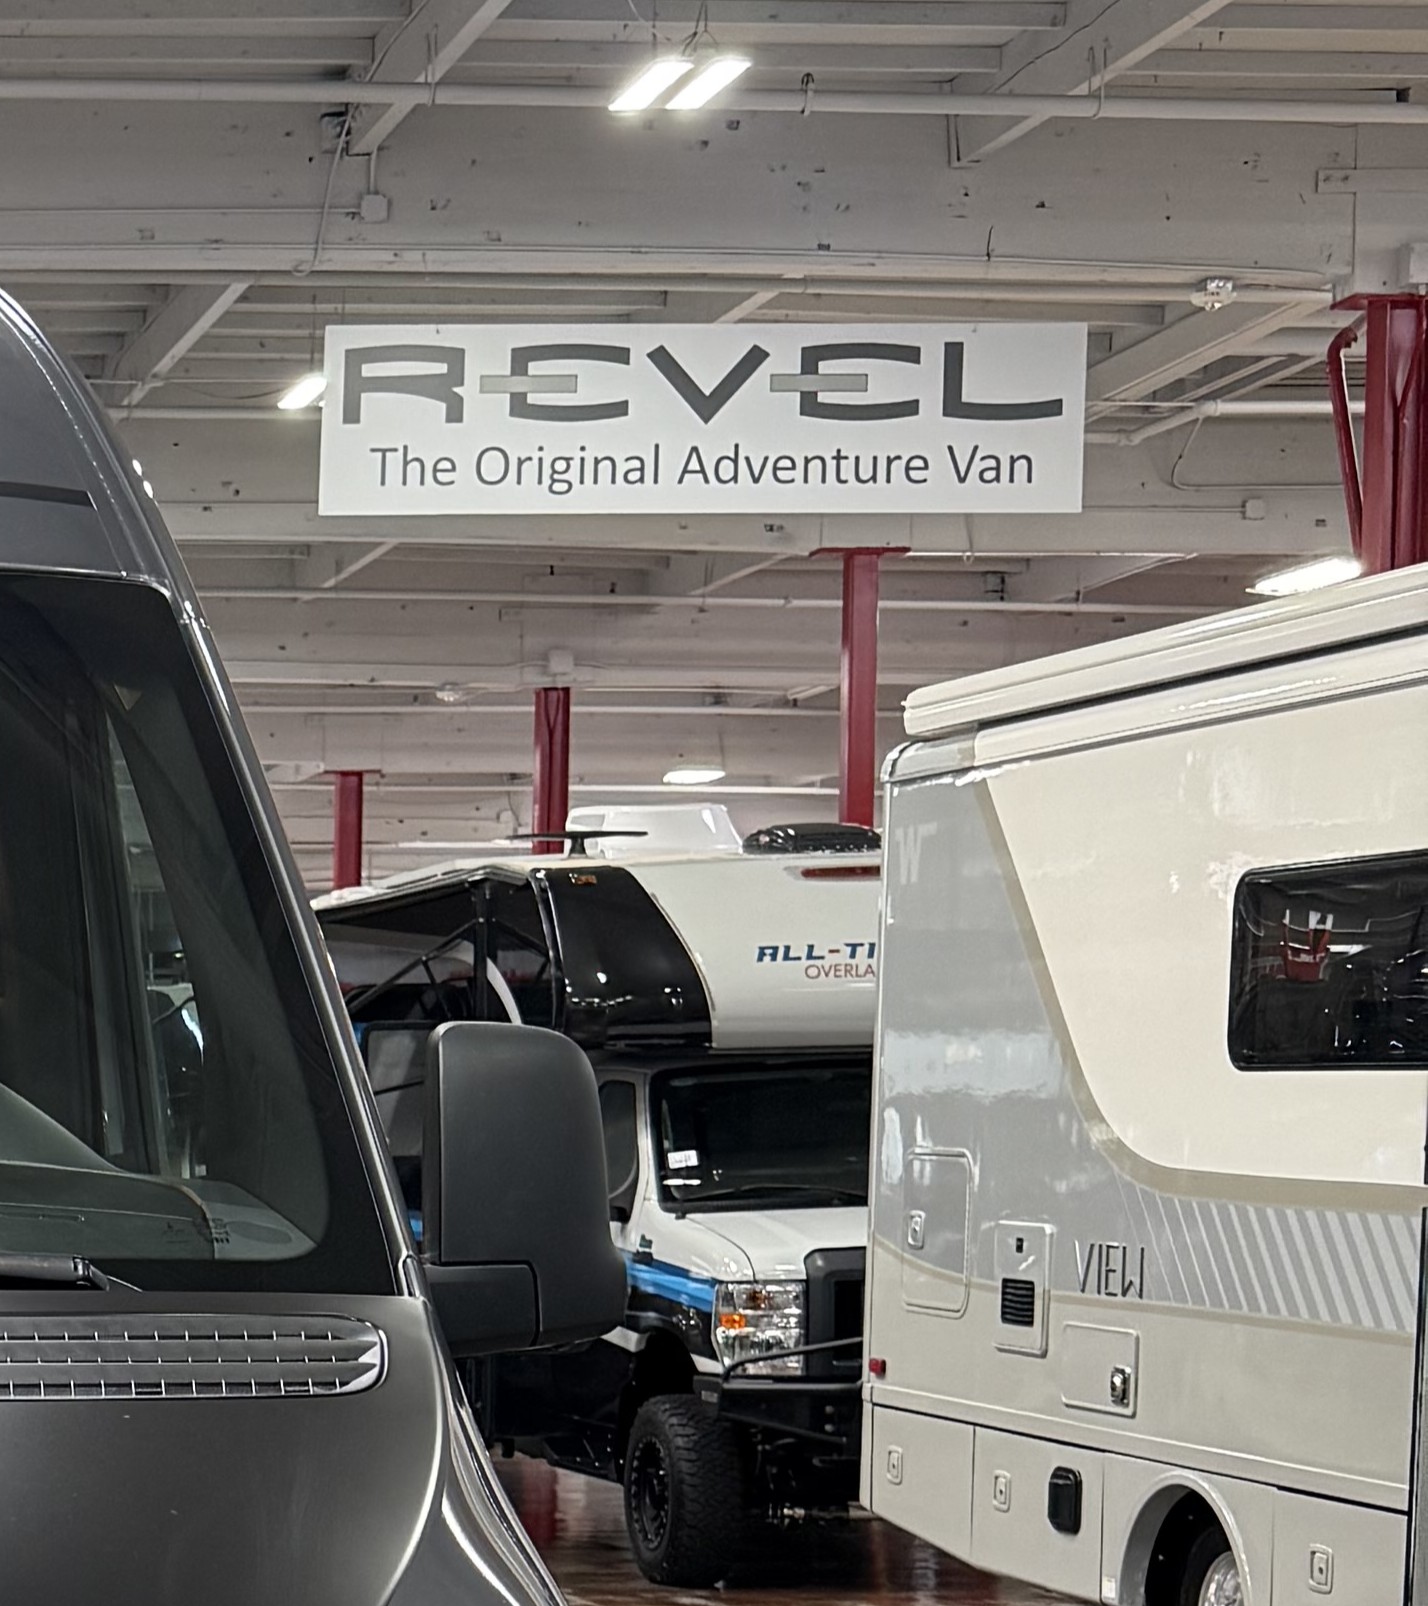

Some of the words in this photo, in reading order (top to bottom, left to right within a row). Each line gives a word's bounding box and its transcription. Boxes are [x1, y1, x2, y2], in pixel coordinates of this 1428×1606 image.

[342, 341, 1064, 425] REVEL
[370, 444, 457, 487] The
[475, 443, 661, 496] Original
[677, 443, 930, 487] Adventure
[947, 444, 1034, 486] Van
[756, 941, 877, 963] ALL-TI
[804, 963, 877, 980] OVERLA
[1073, 1239, 1145, 1300] VIEW
